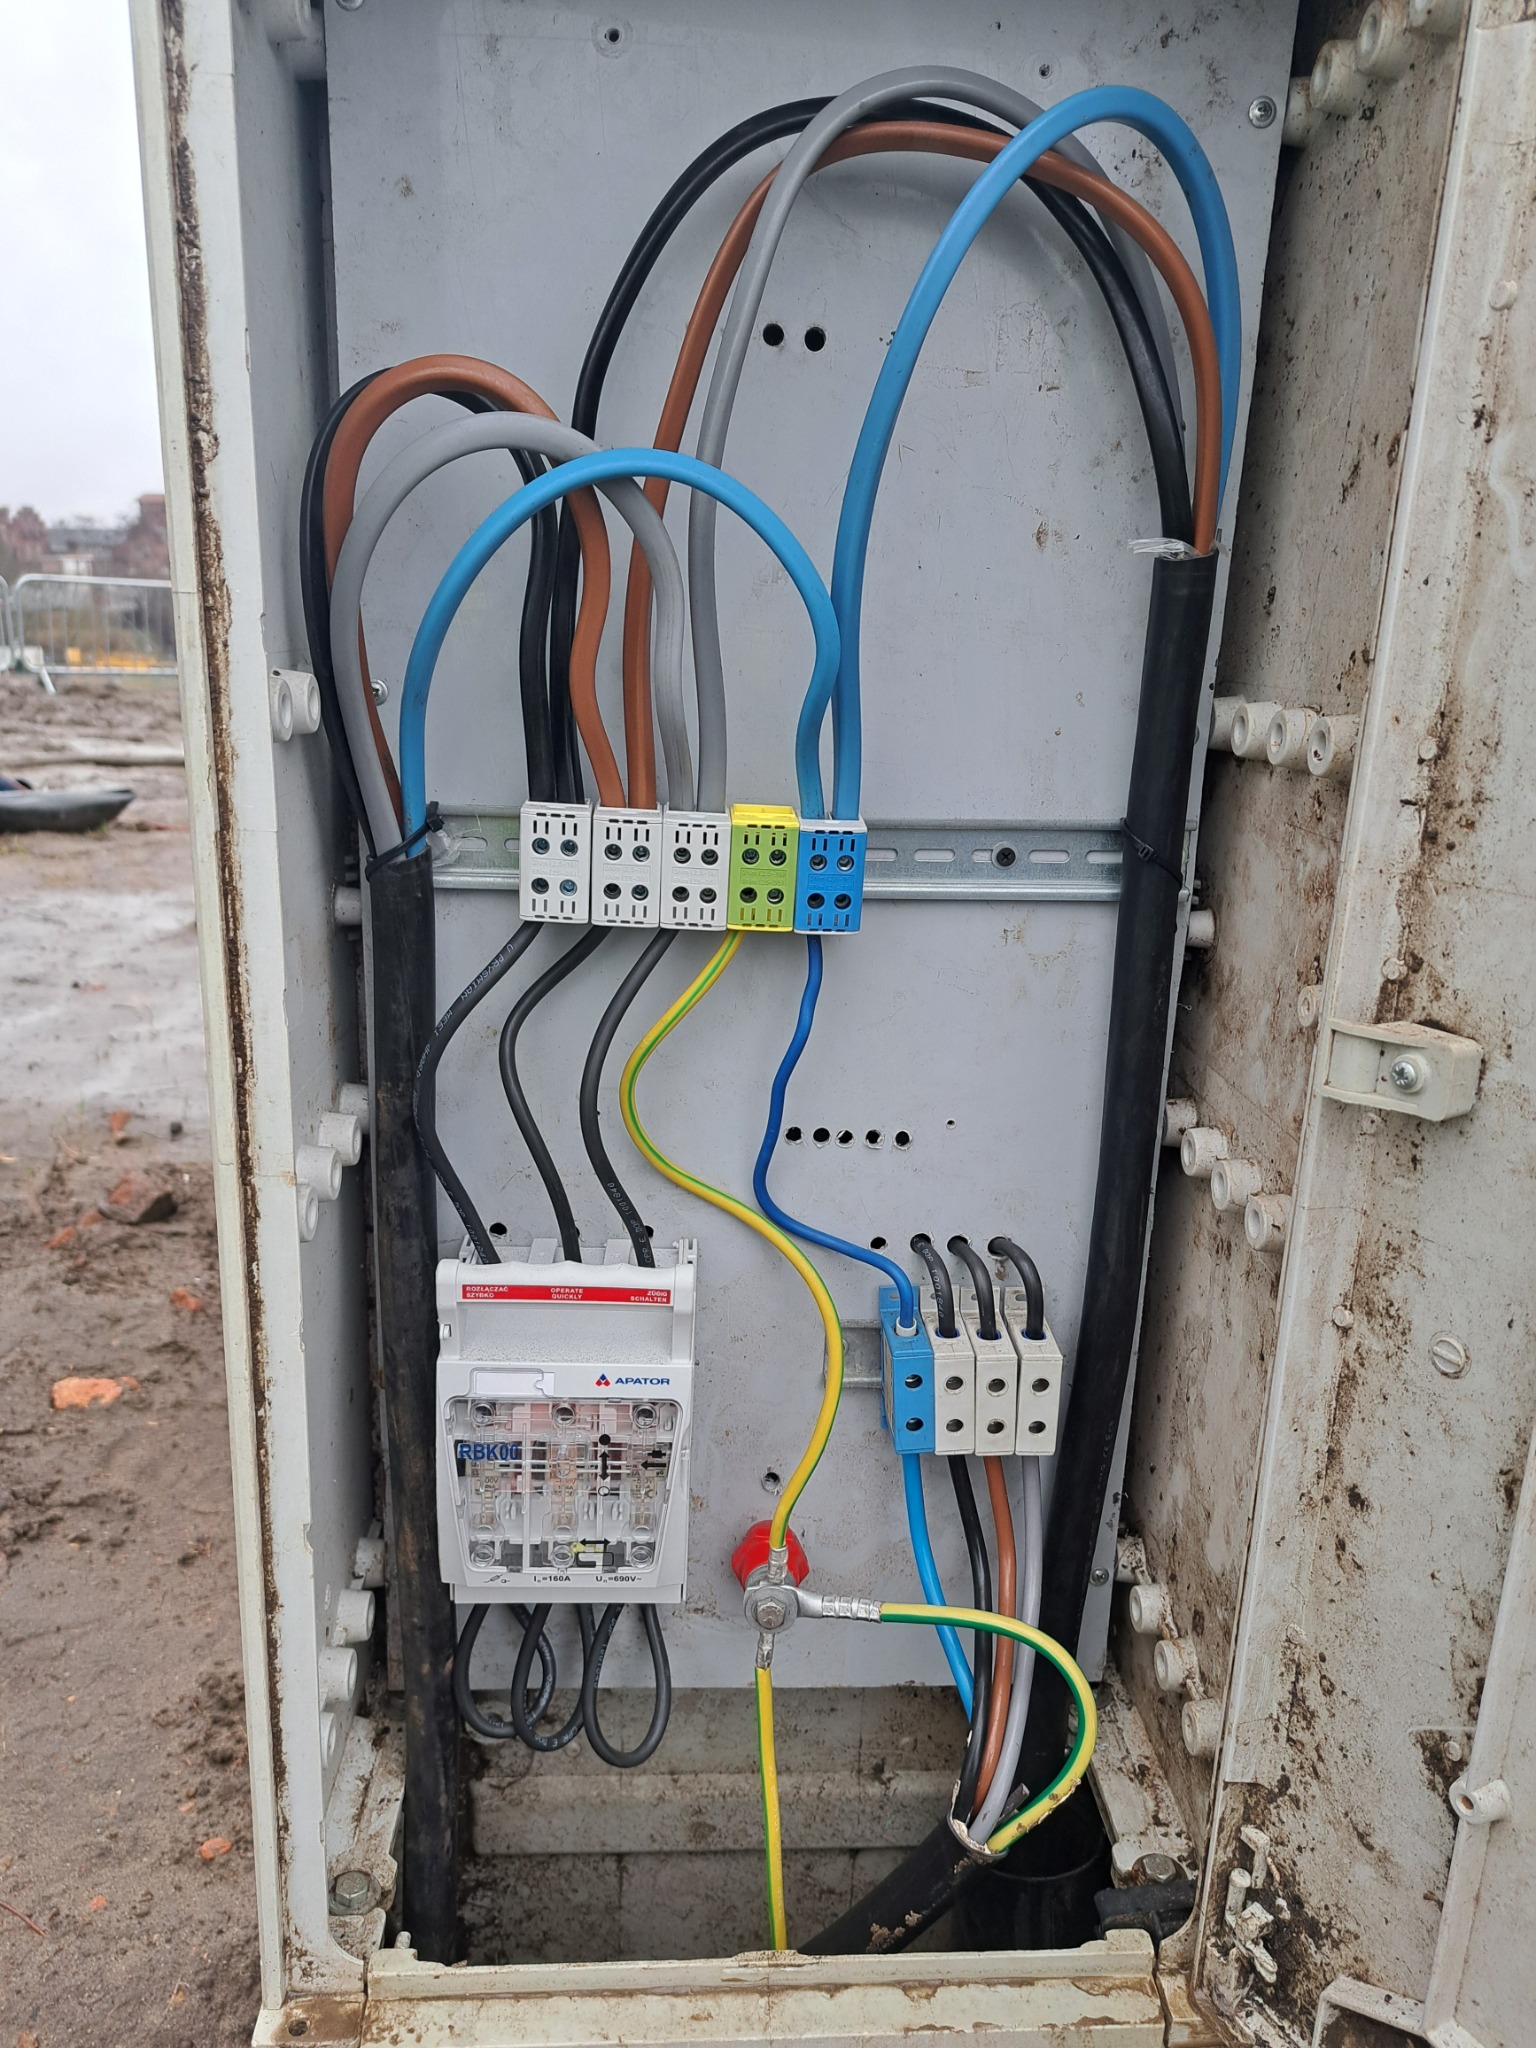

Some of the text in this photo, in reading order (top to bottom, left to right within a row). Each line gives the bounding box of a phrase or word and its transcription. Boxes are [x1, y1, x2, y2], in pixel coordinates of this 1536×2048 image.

[460, 953, 506, 1002] PRYSMIAN
[638, 1235, 647, 1243] E
[641, 1247, 652, 1263] CPR
[615, 1377, 670, 1386] APATOR
[458, 1443, 519, 1460] RBK00
